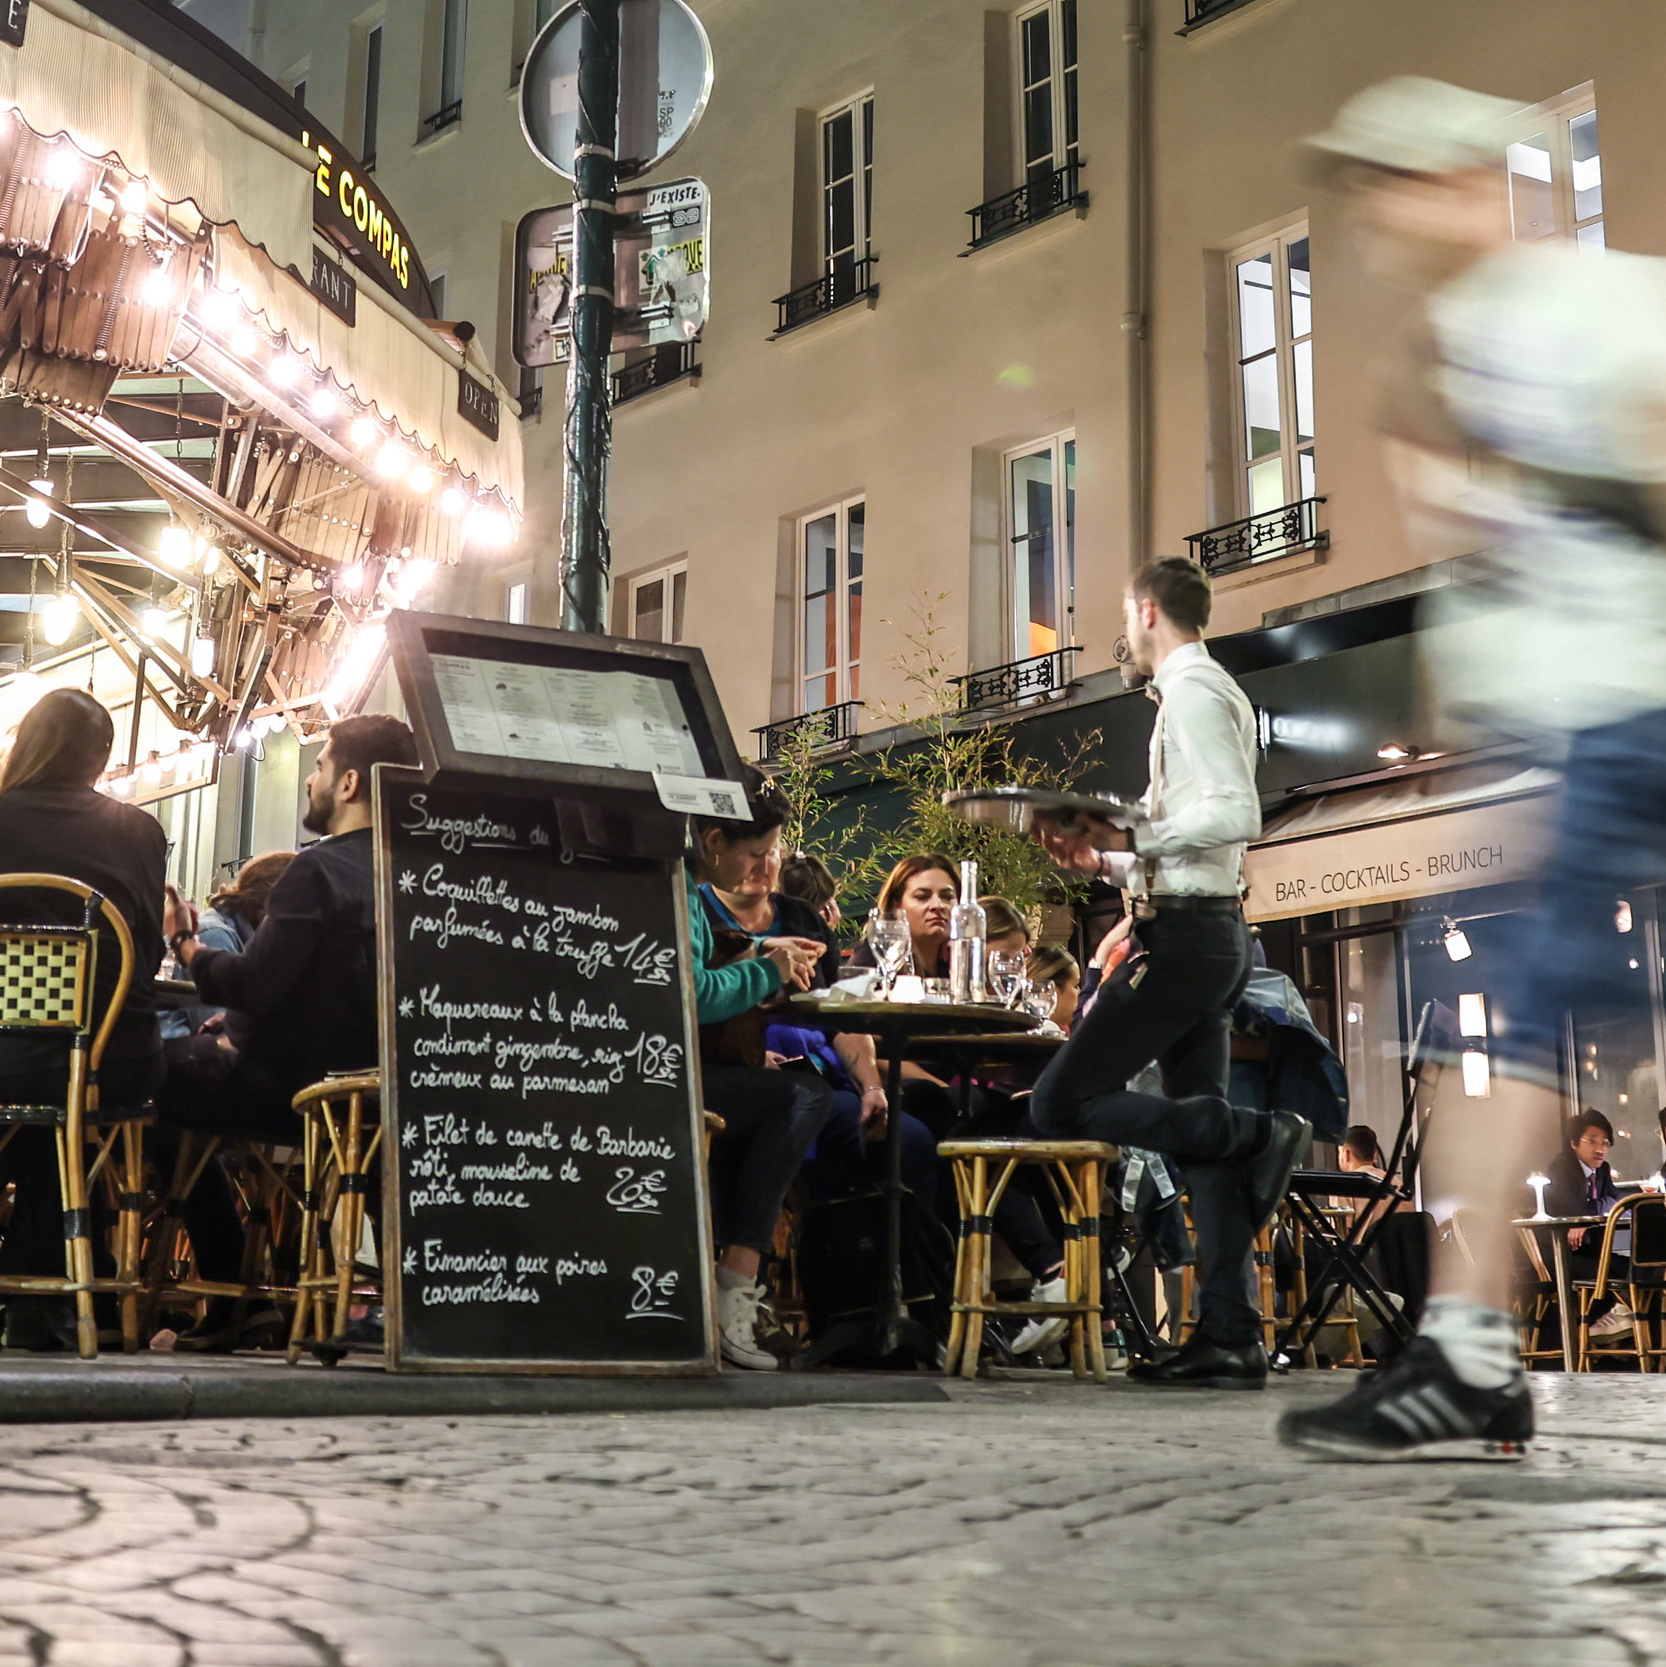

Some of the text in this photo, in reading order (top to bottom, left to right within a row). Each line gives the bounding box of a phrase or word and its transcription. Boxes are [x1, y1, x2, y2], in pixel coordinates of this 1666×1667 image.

[339, 170, 410, 290] COMPAS
[464, 382, 499, 425] OPEN
[401, 794, 517, 854] Suggestions
[423, 863, 520, 914] Coquillettes
[524, 900, 549, 917] au
[1275, 845, 1503, 902] BAR COCKTAILS BRUNCH
[533, 922, 550, 953] la
[556, 930, 615, 980] truffe
[548, 991, 564, 1023] la
[413, 1032, 492, 1058] condiment
[489, 1075, 515, 1090] au
[522, 1077, 609, 1100] parmesan
[423, 1112, 676, 1160] Filet de canette de Barbarie
[460, 1152, 553, 1181] mousseline
[559, 1157, 582, 1182] de
[409, 1179, 530, 1217] patate douce
[515, 1258, 549, 1274] aux
[555, 1251, 608, 1285] poires
